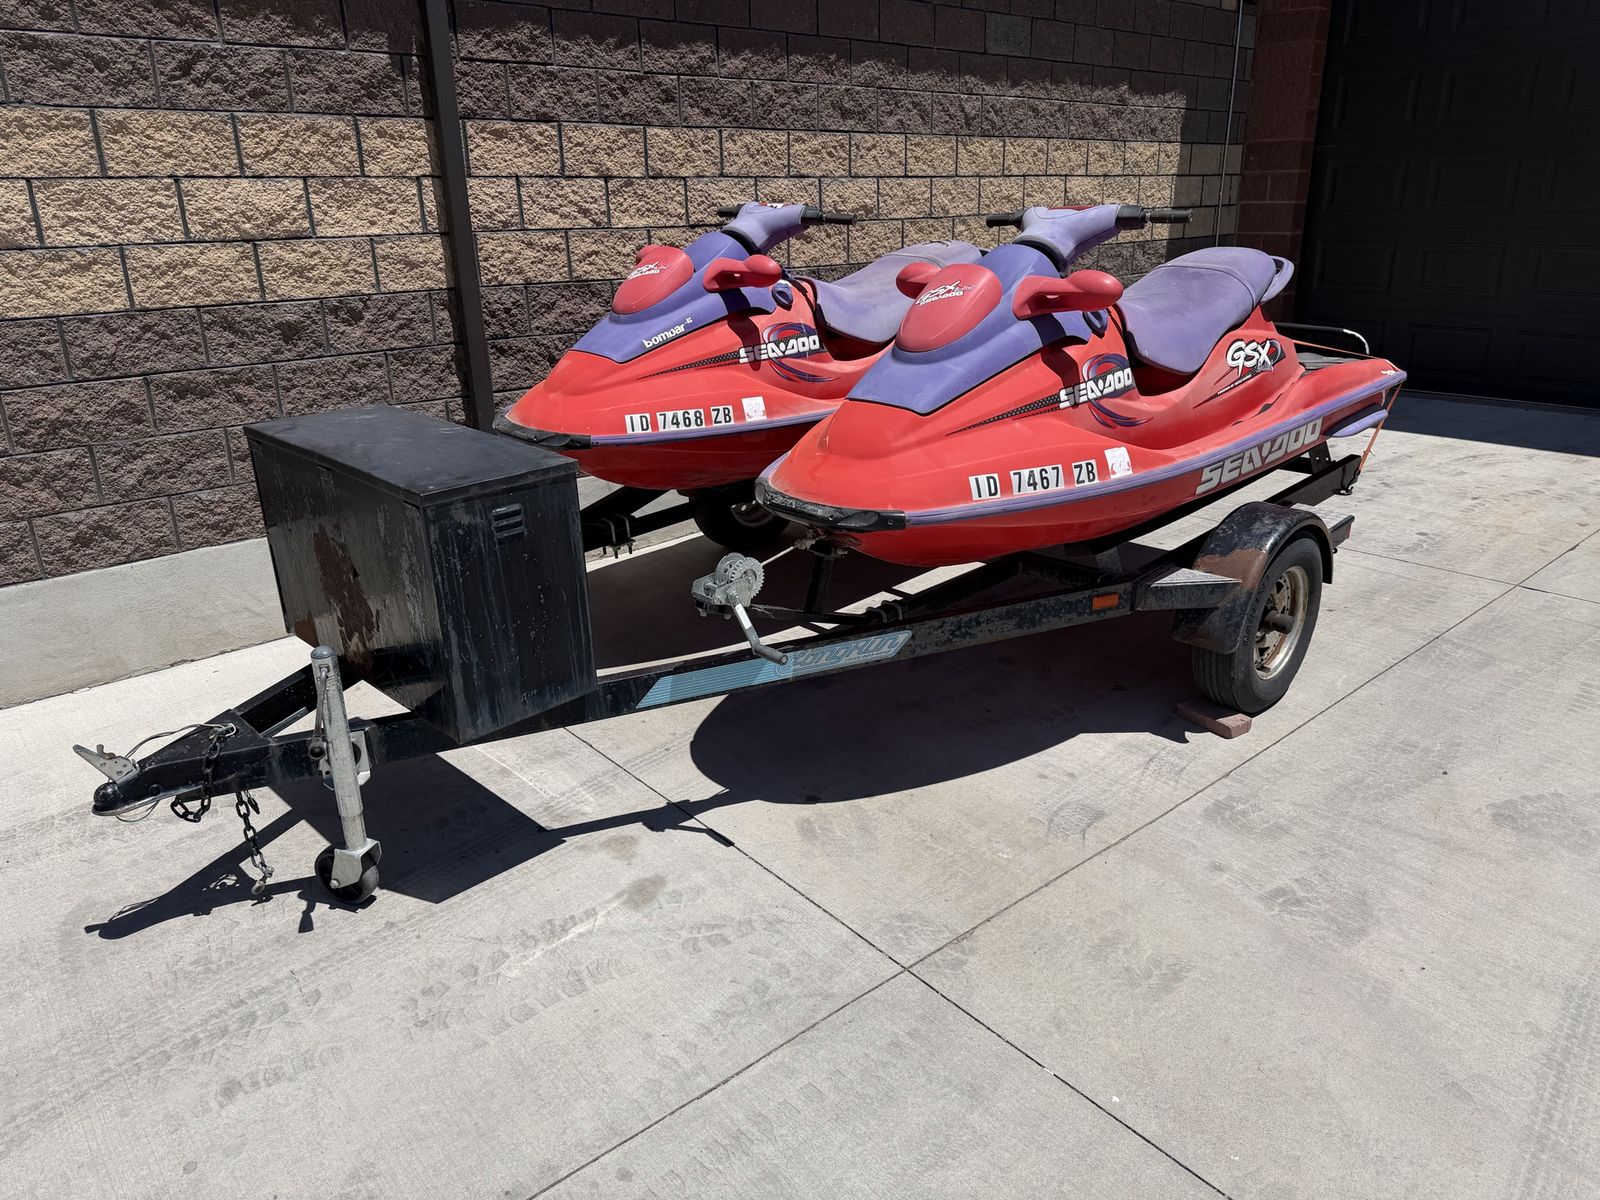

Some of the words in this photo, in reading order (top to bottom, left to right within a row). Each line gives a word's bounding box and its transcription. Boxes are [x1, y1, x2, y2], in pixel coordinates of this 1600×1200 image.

[1226, 339, 1272, 378] GSX
[629, 415, 650, 432] ID
[658, 410, 704, 430] 7468
[711, 407, 732, 424] ZB
[974, 475, 999, 499] ID
[1013, 466, 1061, 493] 7467
[1073, 461, 1097, 485] ZB
